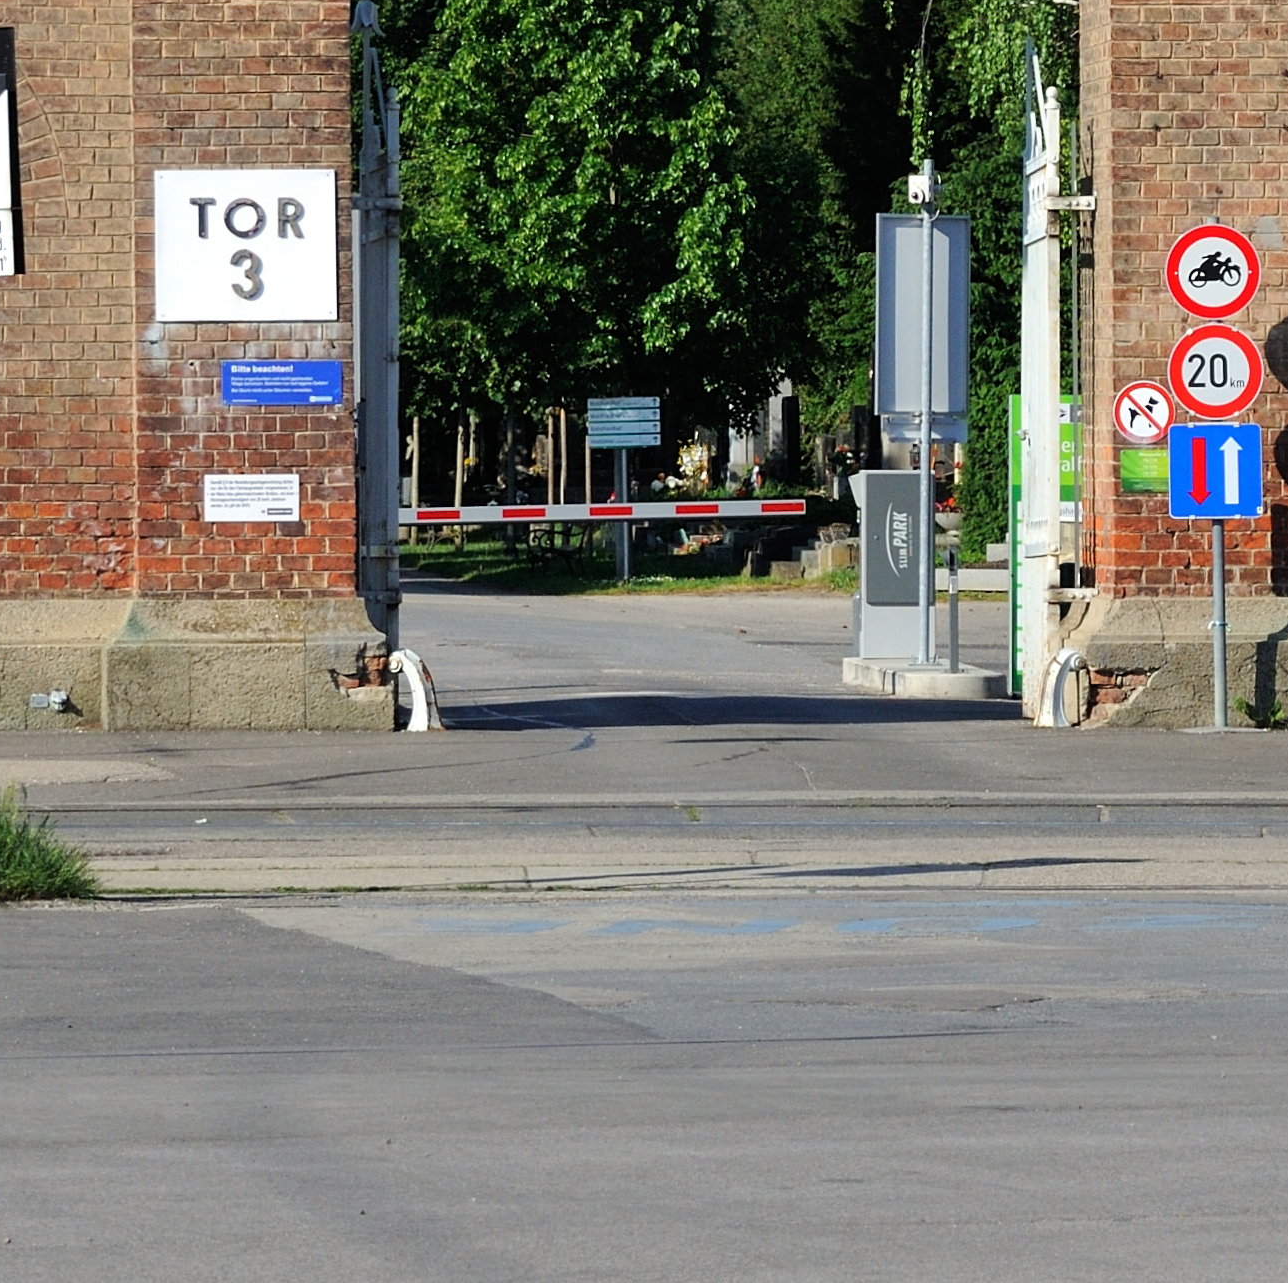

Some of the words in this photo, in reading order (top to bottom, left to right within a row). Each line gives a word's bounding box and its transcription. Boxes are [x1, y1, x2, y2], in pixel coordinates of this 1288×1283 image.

[189, 197, 306, 240] TOR
[229, 248, 265, 301] 3
[231, 365, 251, 373] Bitte
[252, 365, 294, 373] beachten!
[1188, 353, 1228, 388] 20
[1230, 377, 1245, 388] km
